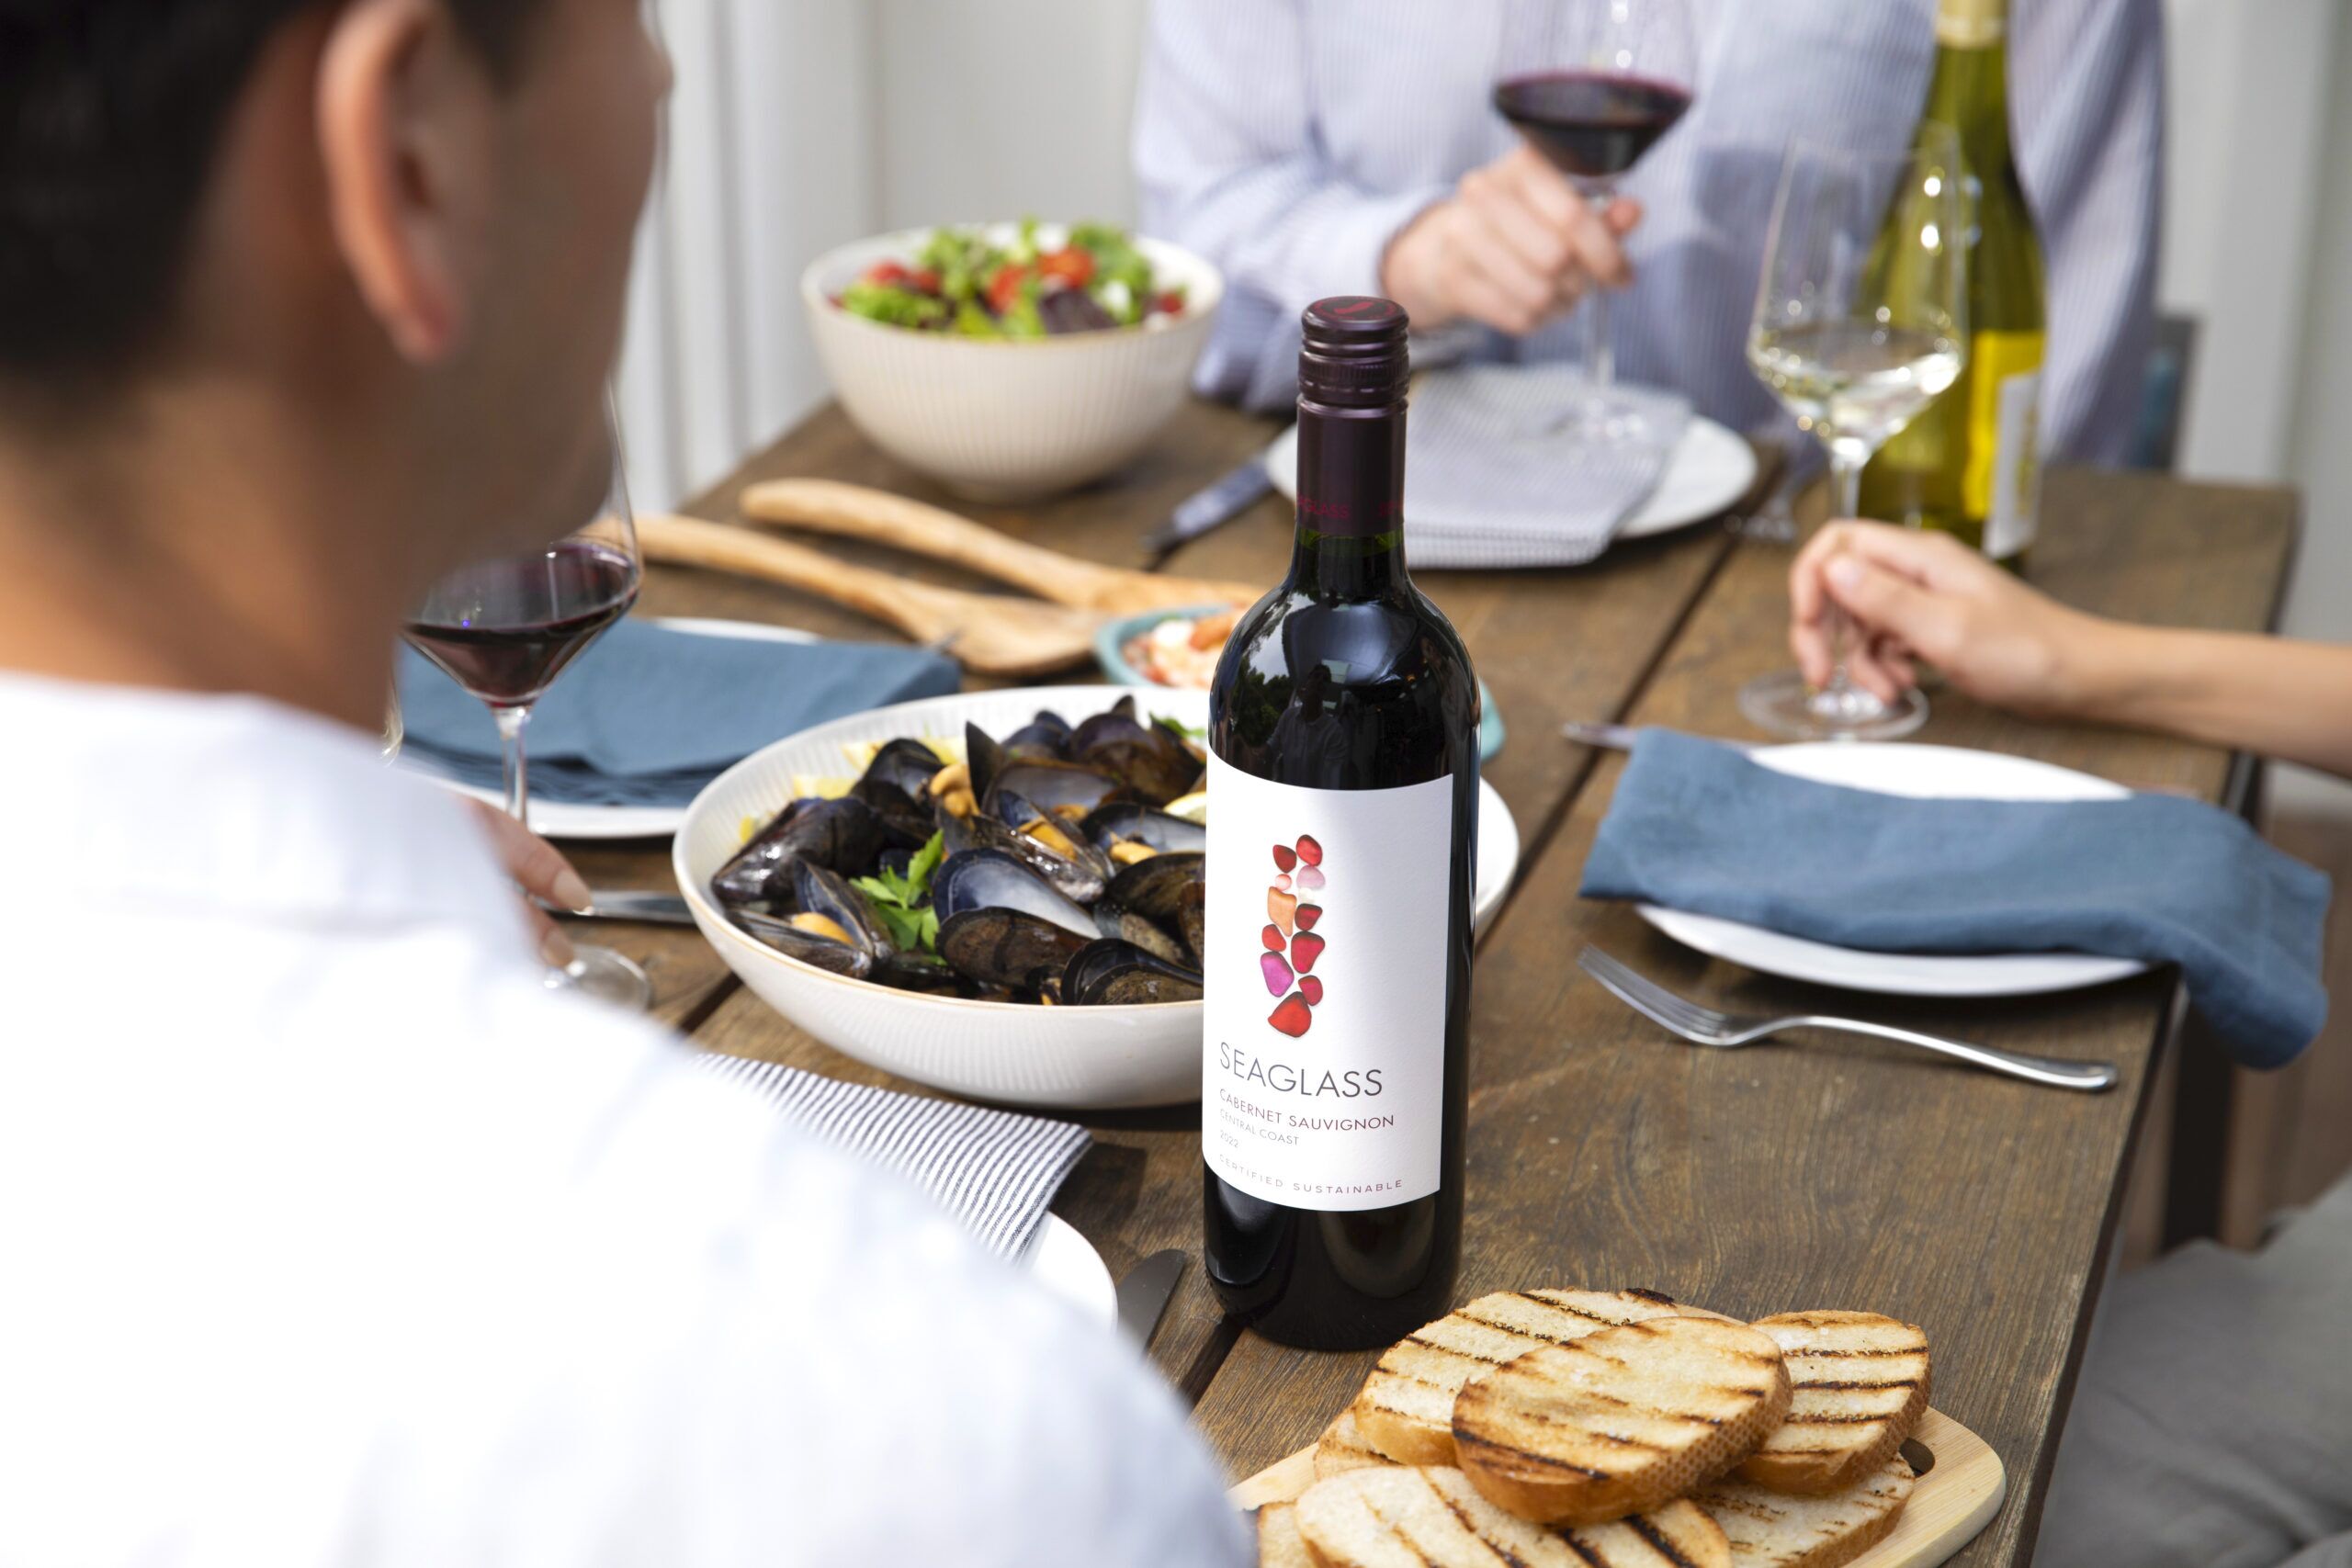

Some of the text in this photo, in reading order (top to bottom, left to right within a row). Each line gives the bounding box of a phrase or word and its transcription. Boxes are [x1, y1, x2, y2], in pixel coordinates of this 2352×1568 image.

[1220, 1042, 1383, 1098] SEAGLASS
[1219, 1089, 1395, 1132] CABERNET SAUVIGNON
[1220, 1109, 1300, 1145] CENTRAL COAST
[1220, 1129, 1239, 1148] 2022
[1219, 1154, 1403, 1195] CERTIFIED SUSTAINABLE
